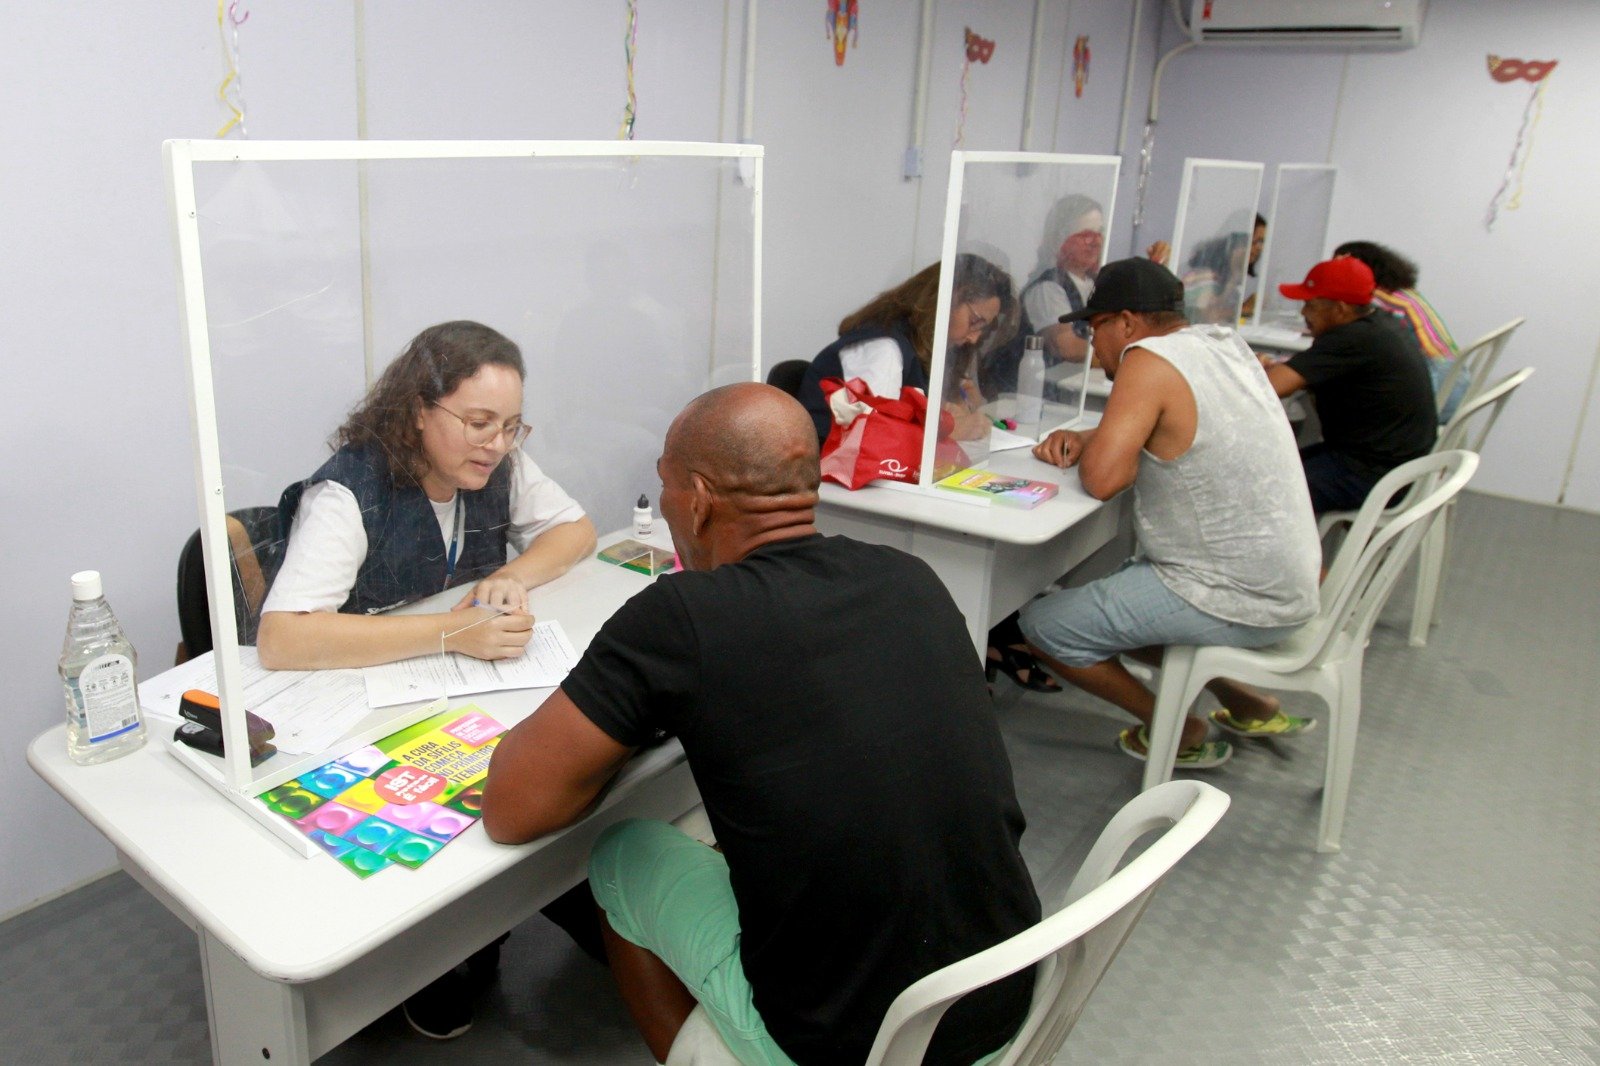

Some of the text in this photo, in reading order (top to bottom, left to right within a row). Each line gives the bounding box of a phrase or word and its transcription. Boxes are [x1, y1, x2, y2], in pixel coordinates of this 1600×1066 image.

[409, 741, 439, 757] CURA
[450, 744, 495, 770] PRIMEIRO
[412, 757, 431, 767] DA
[424, 750, 466, 772] COMEÇA
[383, 770, 415, 791] IST
